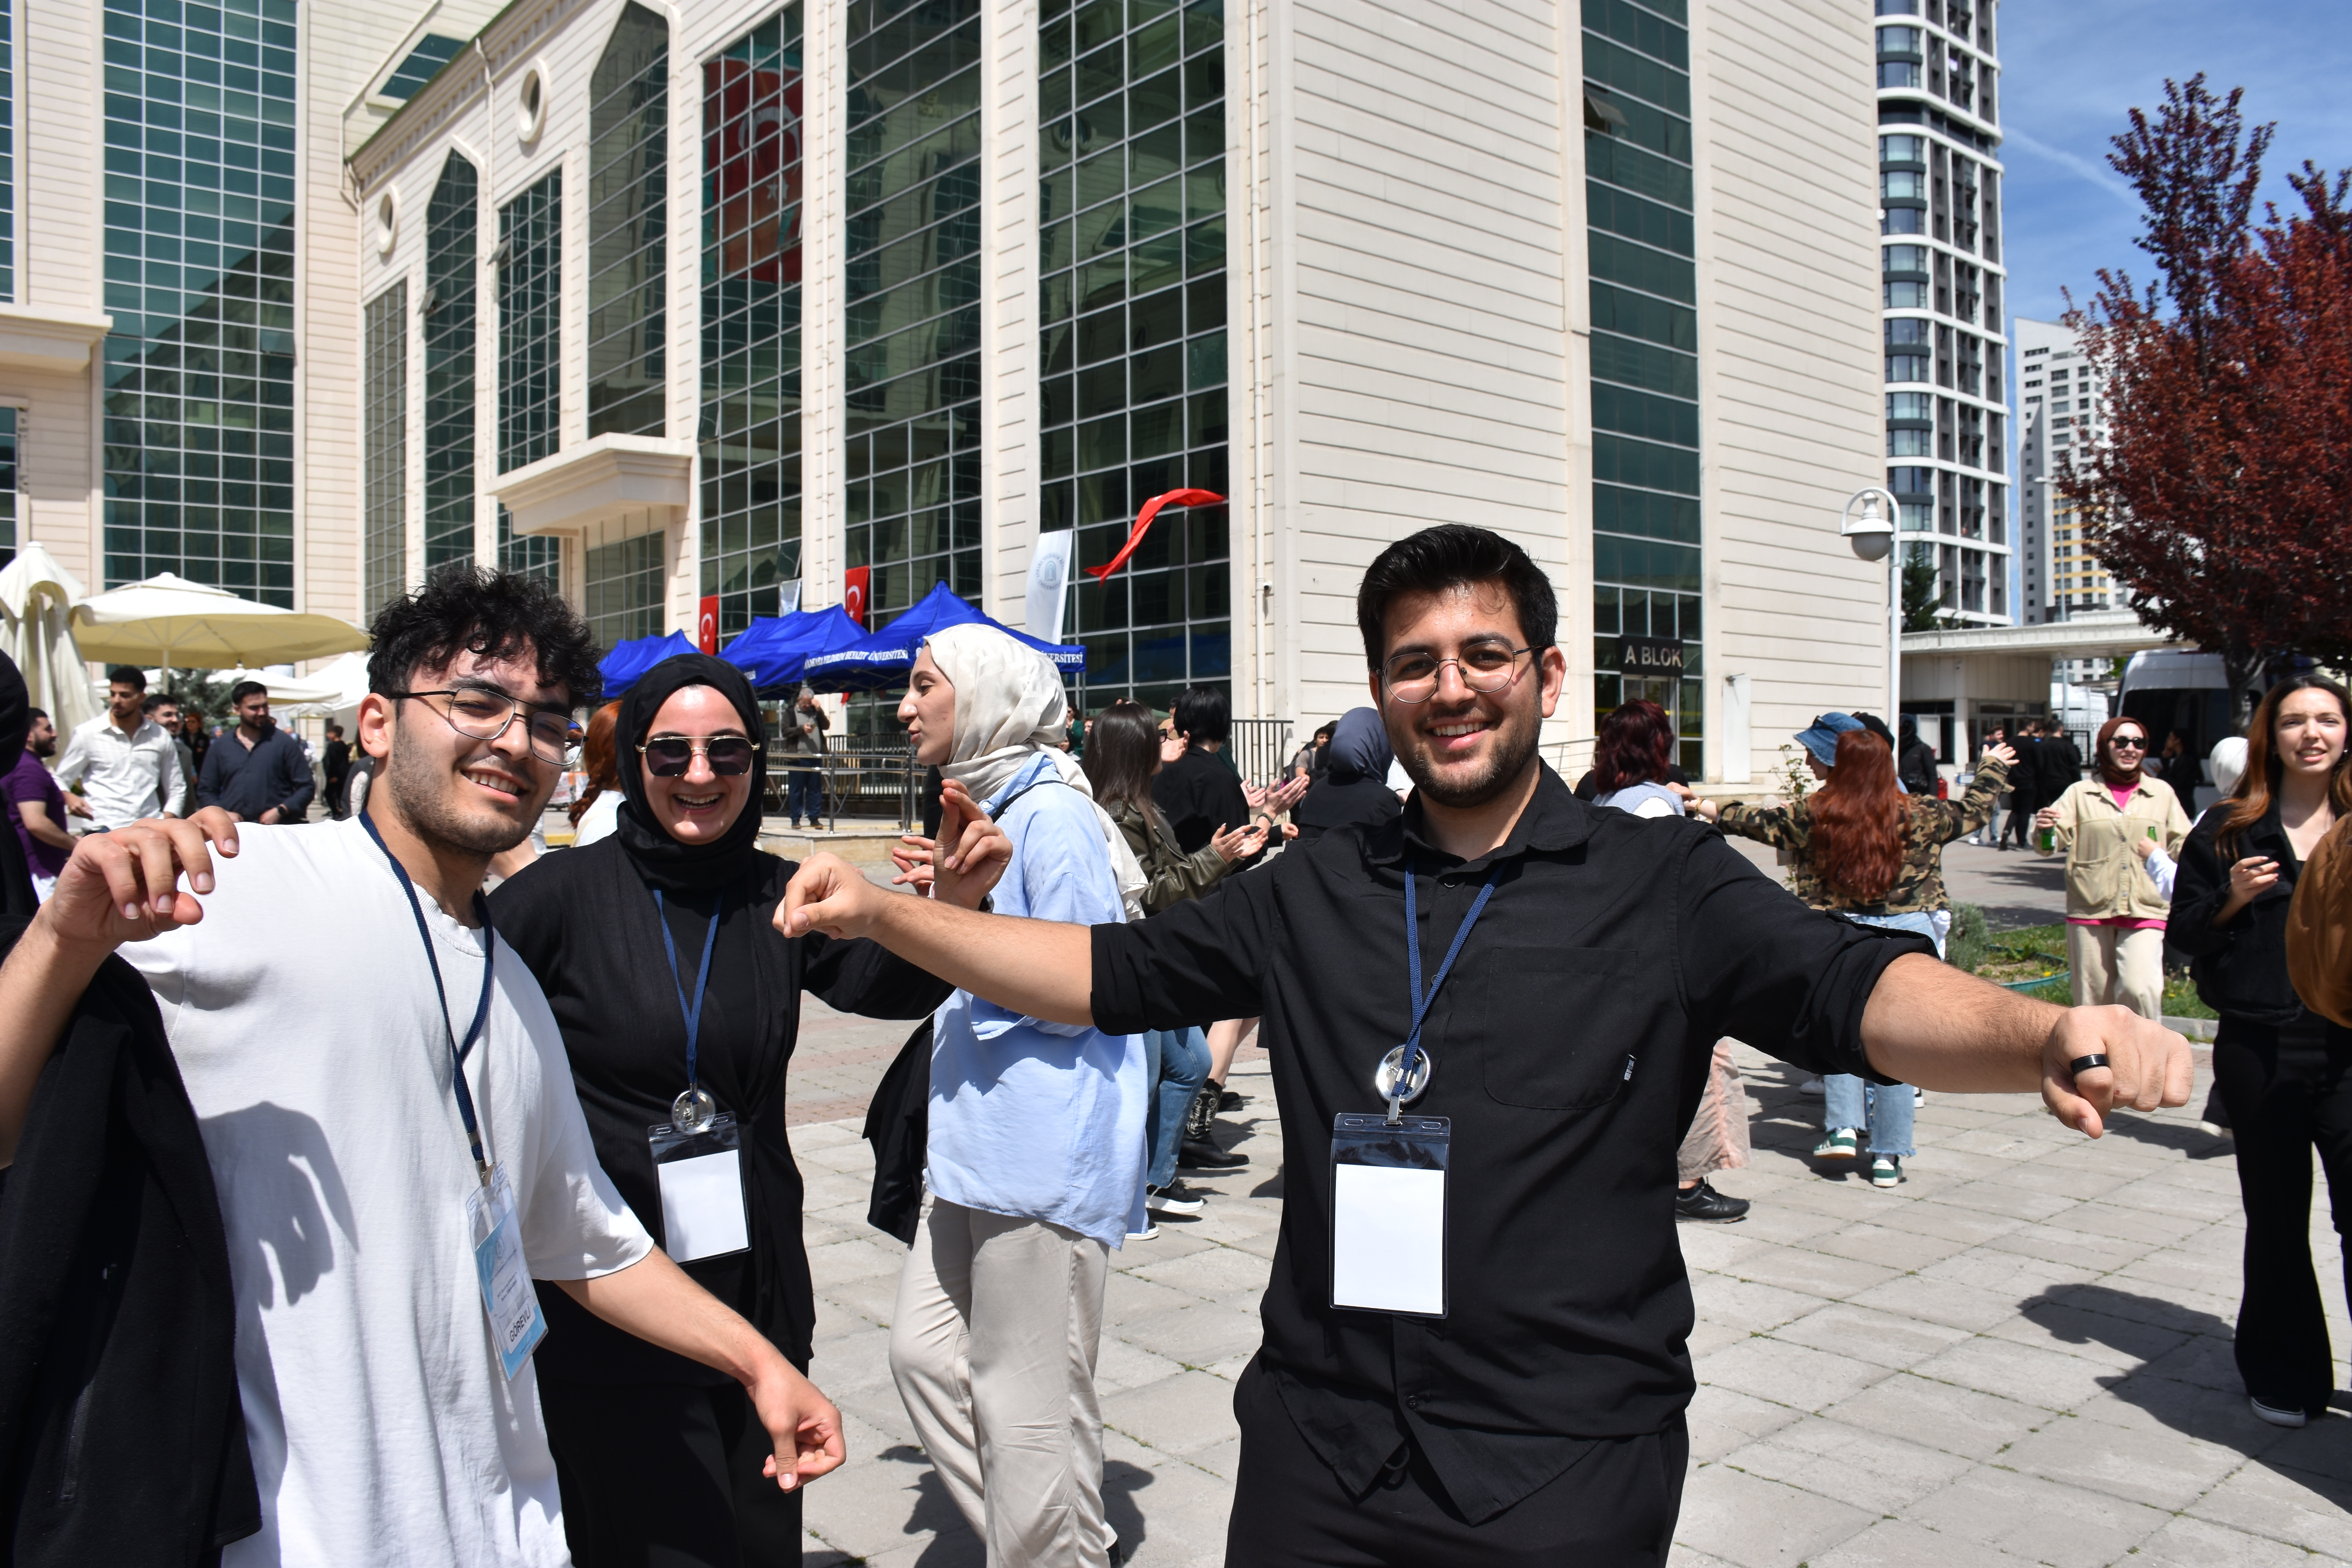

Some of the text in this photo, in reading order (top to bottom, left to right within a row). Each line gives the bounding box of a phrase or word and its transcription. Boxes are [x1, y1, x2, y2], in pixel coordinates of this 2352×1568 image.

[1625, 645, 1682, 668] A BLOK
[510, 1303, 531, 1342] GÖREVLİ
